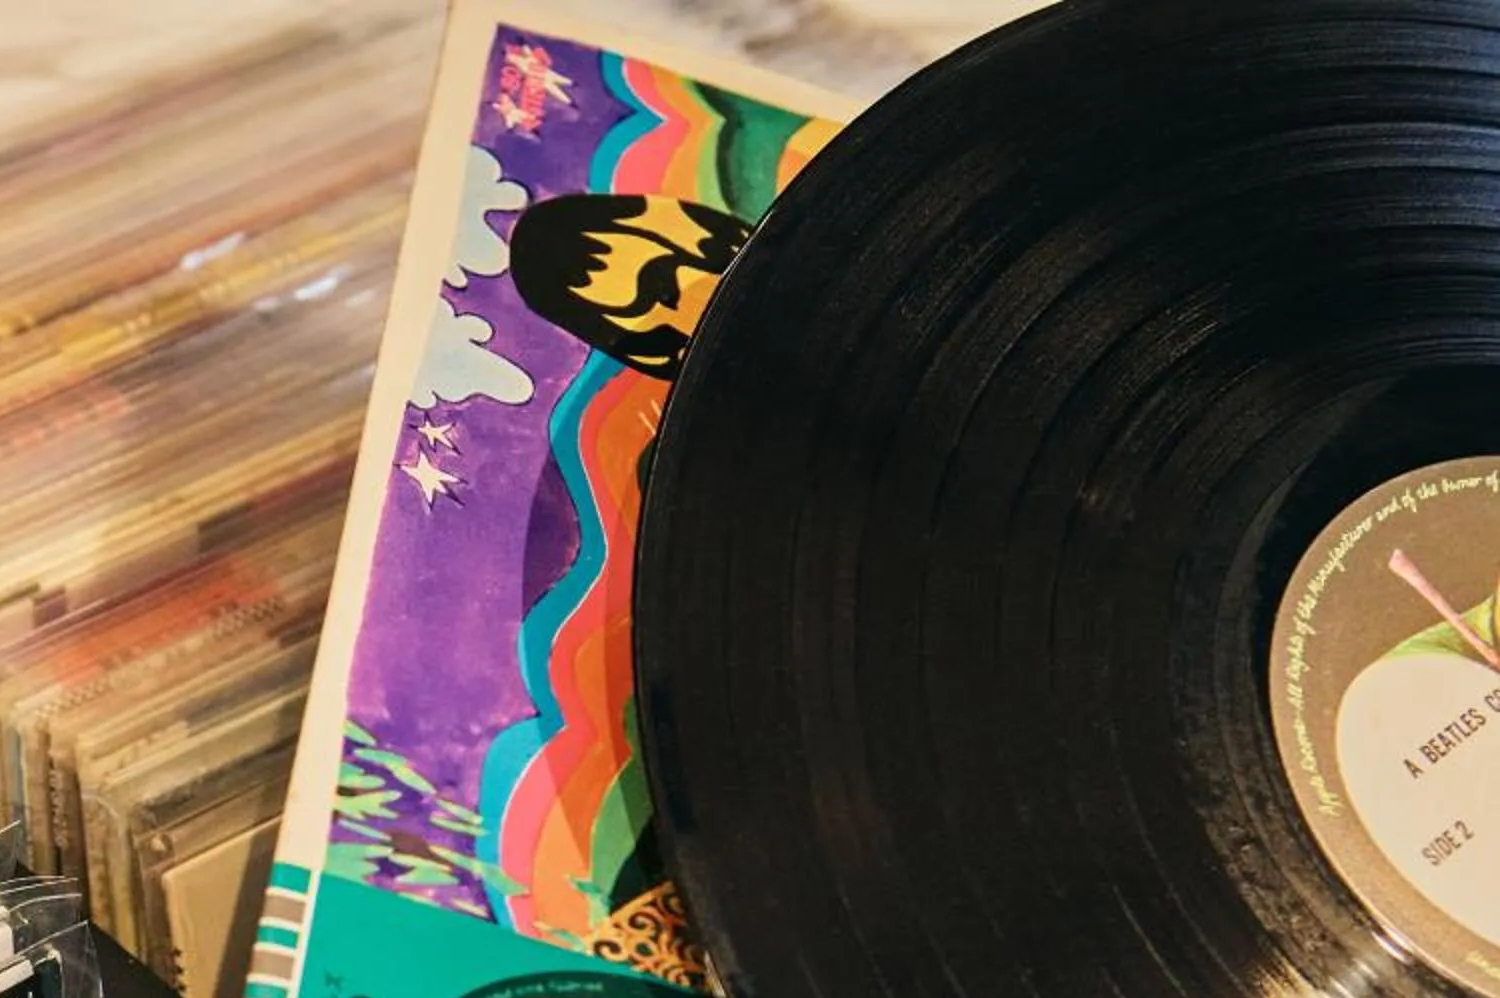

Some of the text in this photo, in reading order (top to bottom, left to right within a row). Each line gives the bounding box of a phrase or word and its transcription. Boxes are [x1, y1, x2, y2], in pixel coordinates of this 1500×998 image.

[1403, 758, 1425, 779] A
[1419, 708, 1487, 764] BEATLES
[1420, 818, 1474, 868] SIDE 2
